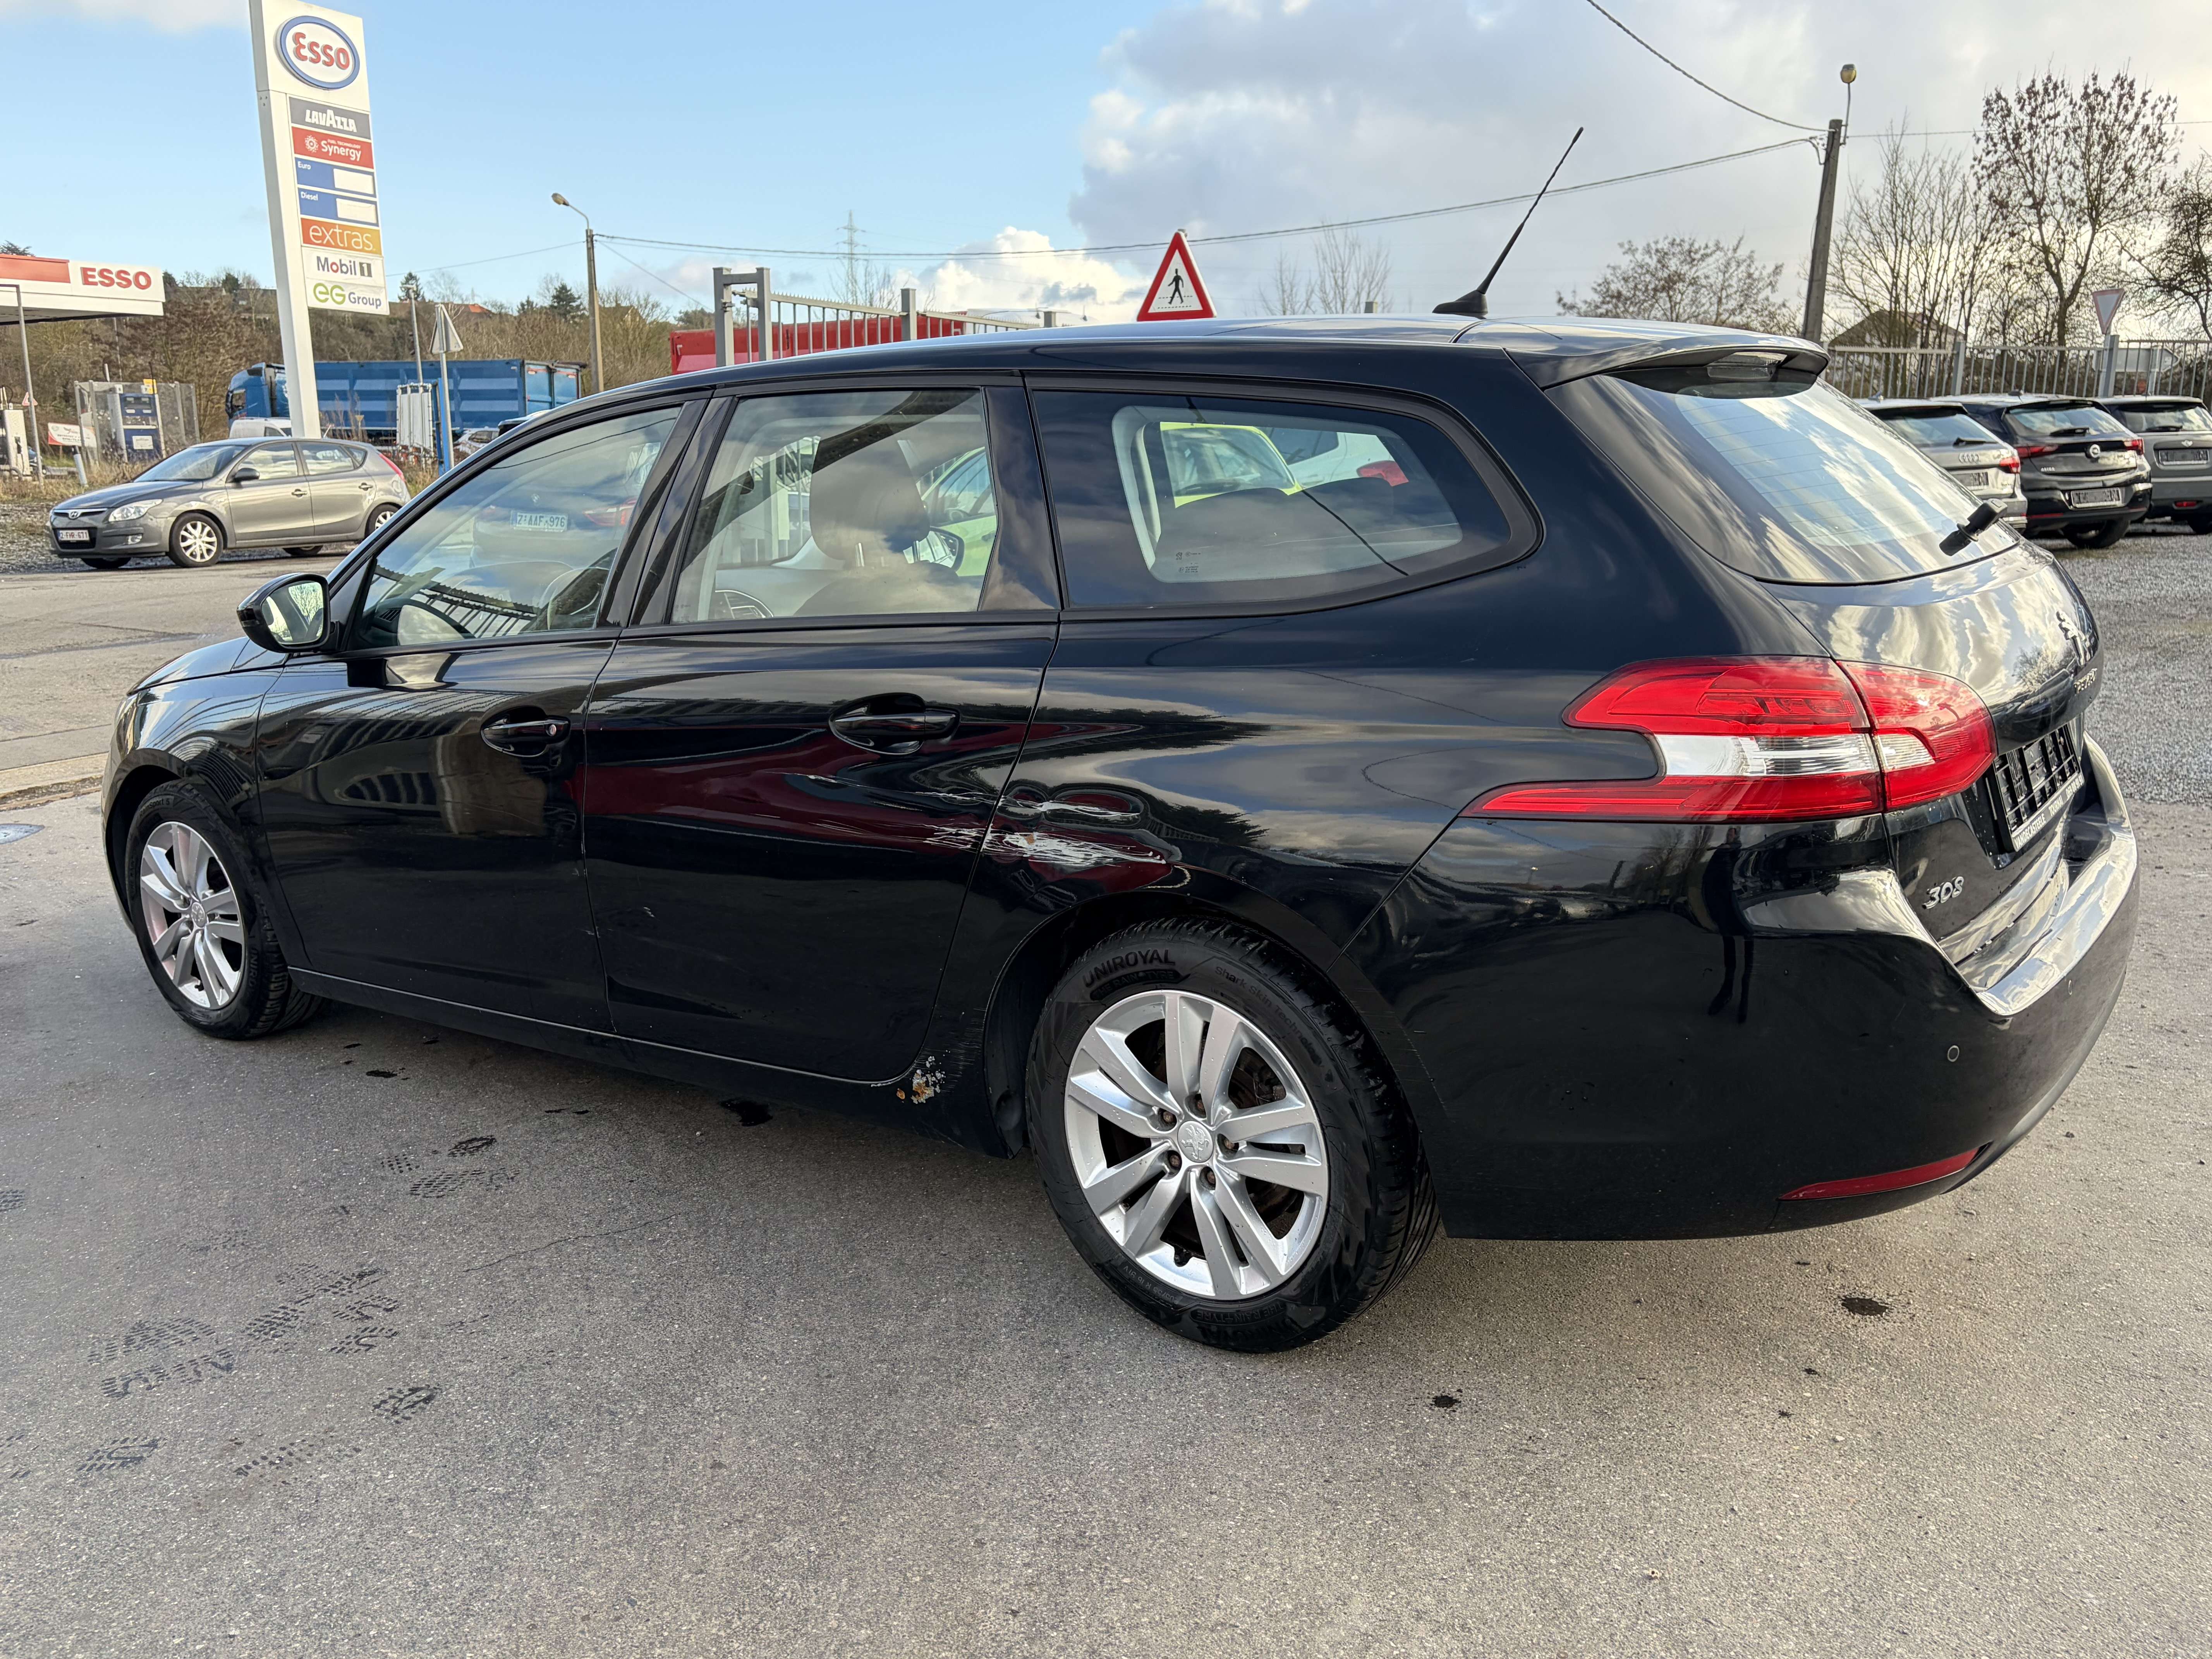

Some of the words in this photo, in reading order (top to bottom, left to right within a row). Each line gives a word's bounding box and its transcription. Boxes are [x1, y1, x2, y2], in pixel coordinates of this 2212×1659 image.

[321, 140, 362, 161] Synergy
[298, 161, 311, 170] Euro
[301, 191, 318, 201] Diesel
[80, 266, 152, 290] ESSO
[316, 256, 357, 276] Mobil
[361, 262, 371, 278] 1
[348, 292, 381, 309] Group
[2014, 813, 2046, 850] VANDECASTEELE
[1922, 876, 1964, 909] 308
[1083, 949, 1176, 988] UNIROYAL
[1113, 973, 1138, 987] RAIN
[1146, 971, 1175, 979] TYRE
[1214, 966, 1247, 989] Shark
[1248, 985, 1272, 1006] Skin
